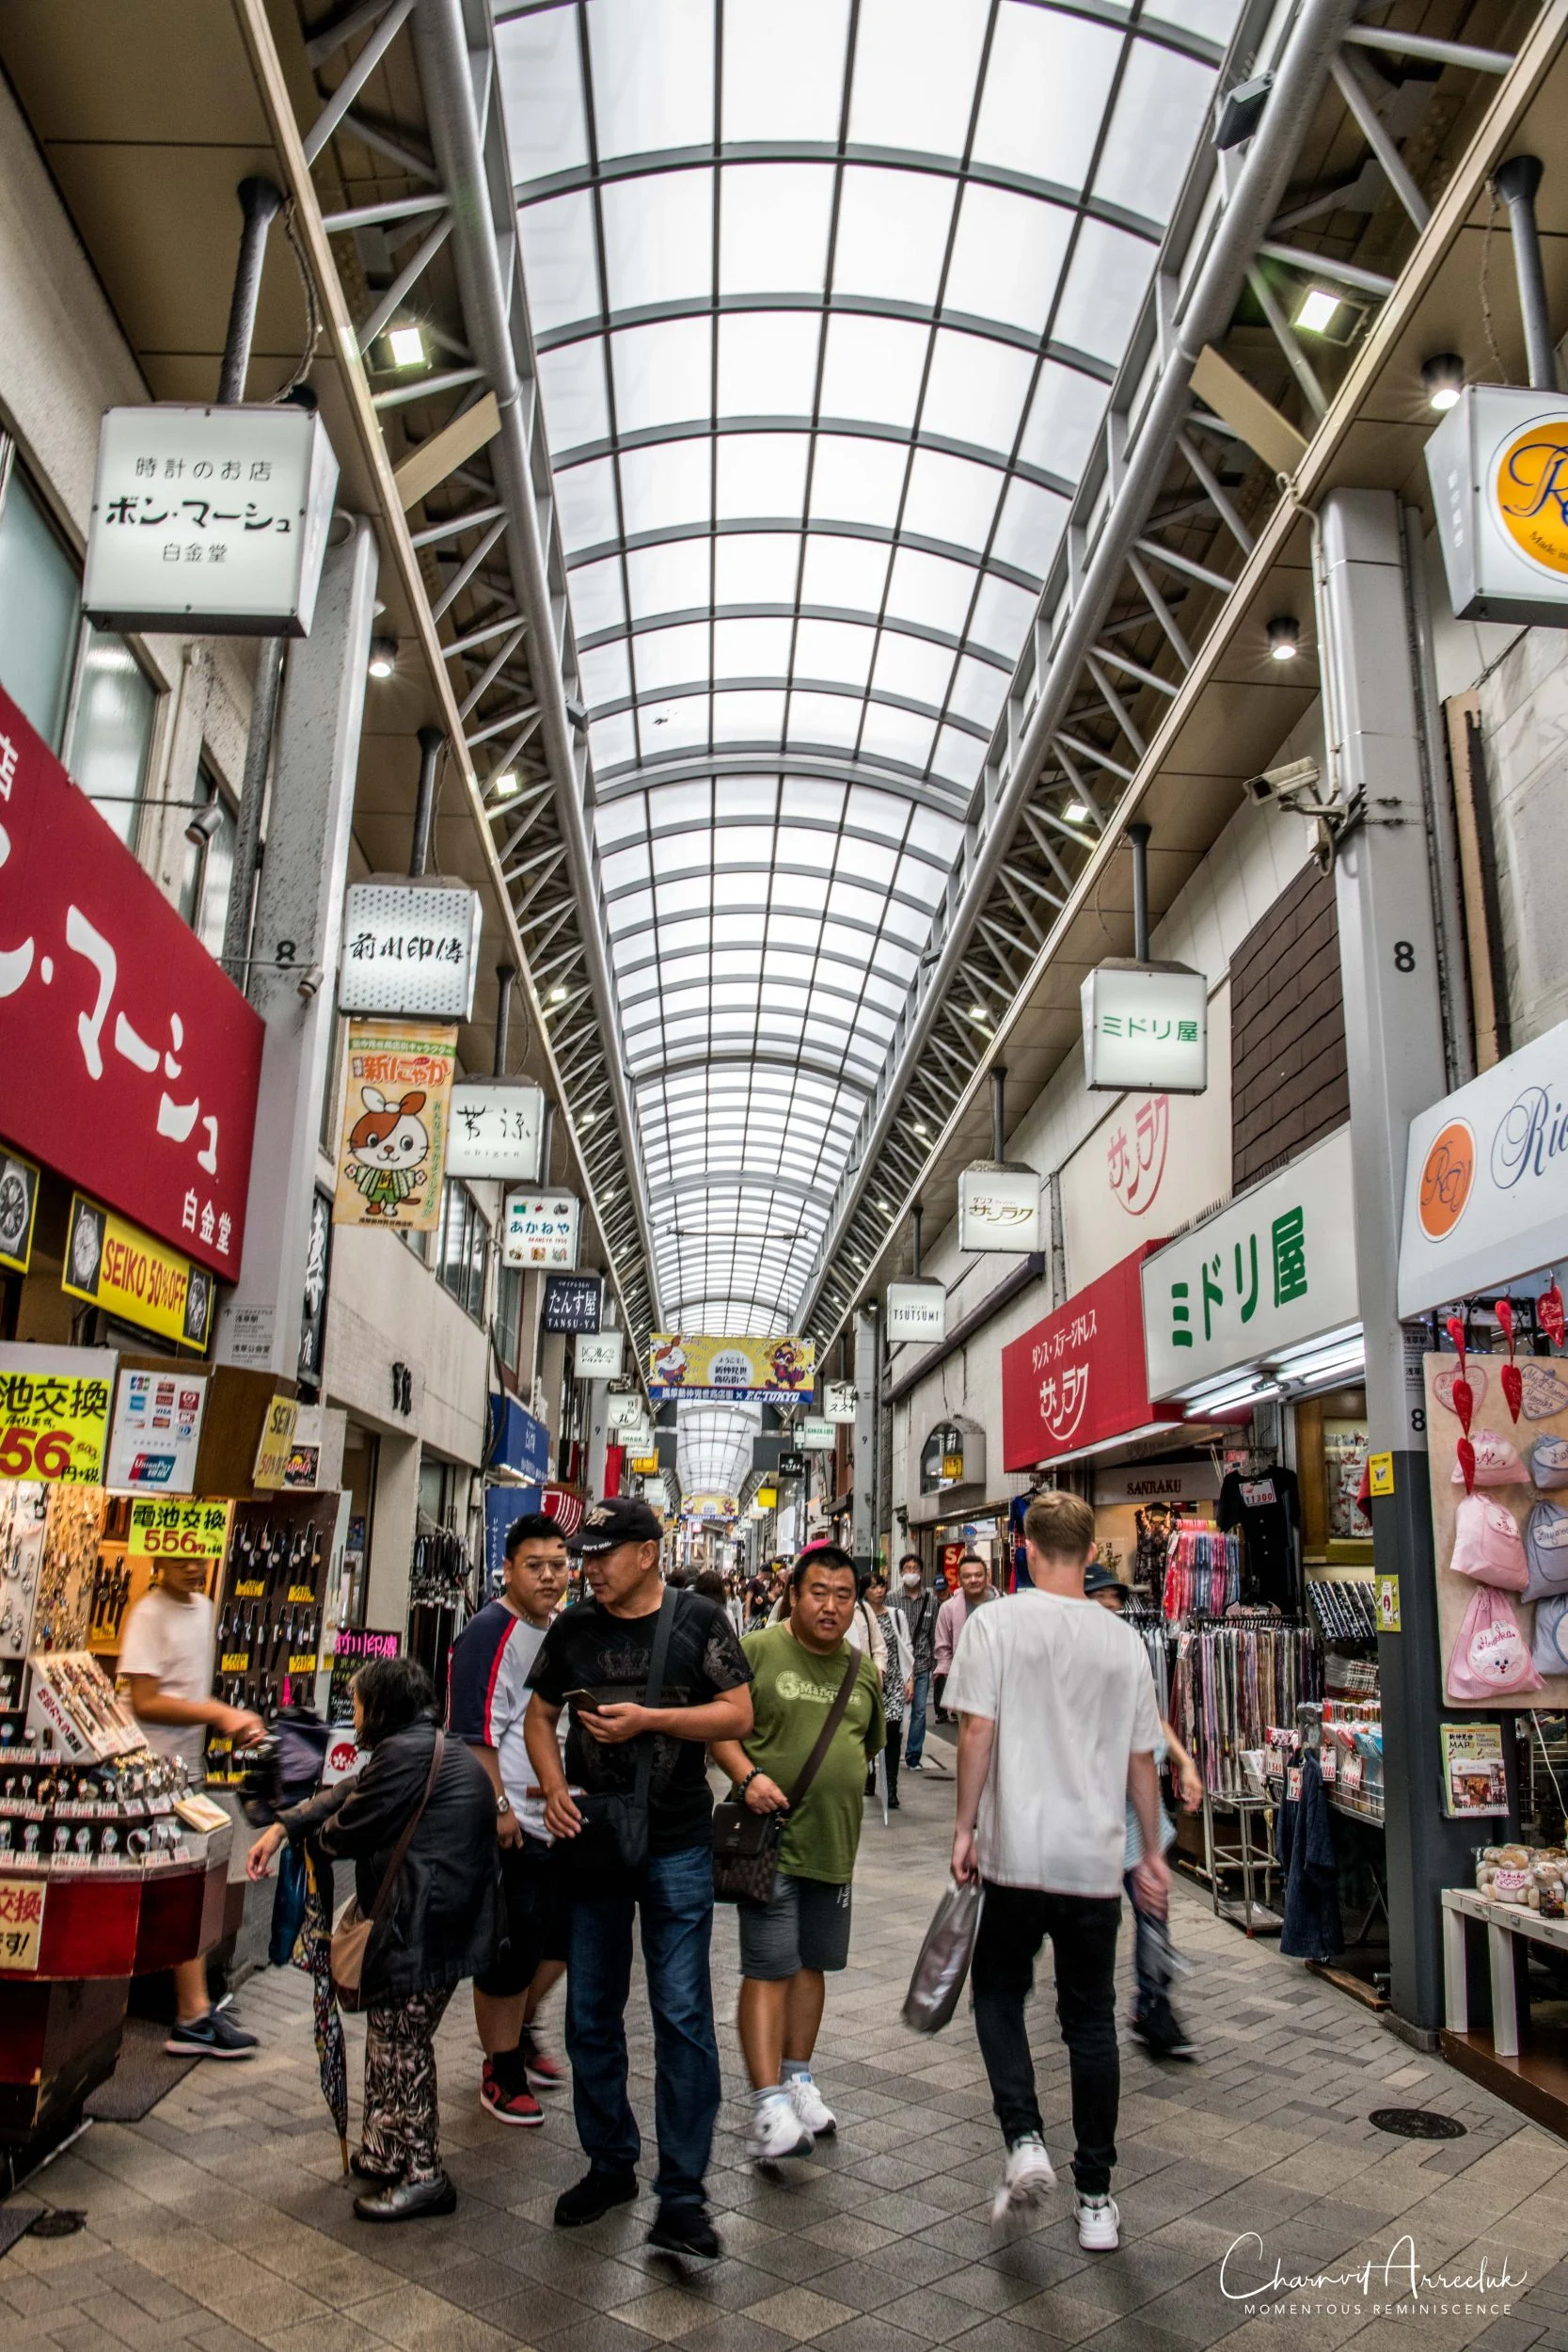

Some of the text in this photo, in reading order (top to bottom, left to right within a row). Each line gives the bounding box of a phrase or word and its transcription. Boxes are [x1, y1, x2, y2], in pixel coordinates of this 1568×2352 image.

[135, 457, 273, 482] 時計のお店
[105, 496, 292, 533] ボン・マーシュ
[163, 543, 227, 563] 白金堂
[276, 941, 296, 968] 8
[1394, 941, 1417, 974] 8
[1101, 1016, 1199, 1042] ミドリ屋
[182, 1187, 232, 1256] 白金堂
[510, 1220, 570, 1235] あかねや
[103, 1238, 187, 1314] SEIKO 50%OFF
[1172, 1204, 1308, 1348] ミドリ屋
[549, 1290, 596, 1316] たんす屋
[895, 1309, 939, 1322] TSUTSUMI
[1411, 1408, 1426, 1432] 8
[135, 1458, 171, 1471] UnionPay
[1127, 1479, 1181, 1496] SANRAKU
[134, 1504, 226, 1531] 電池交換
